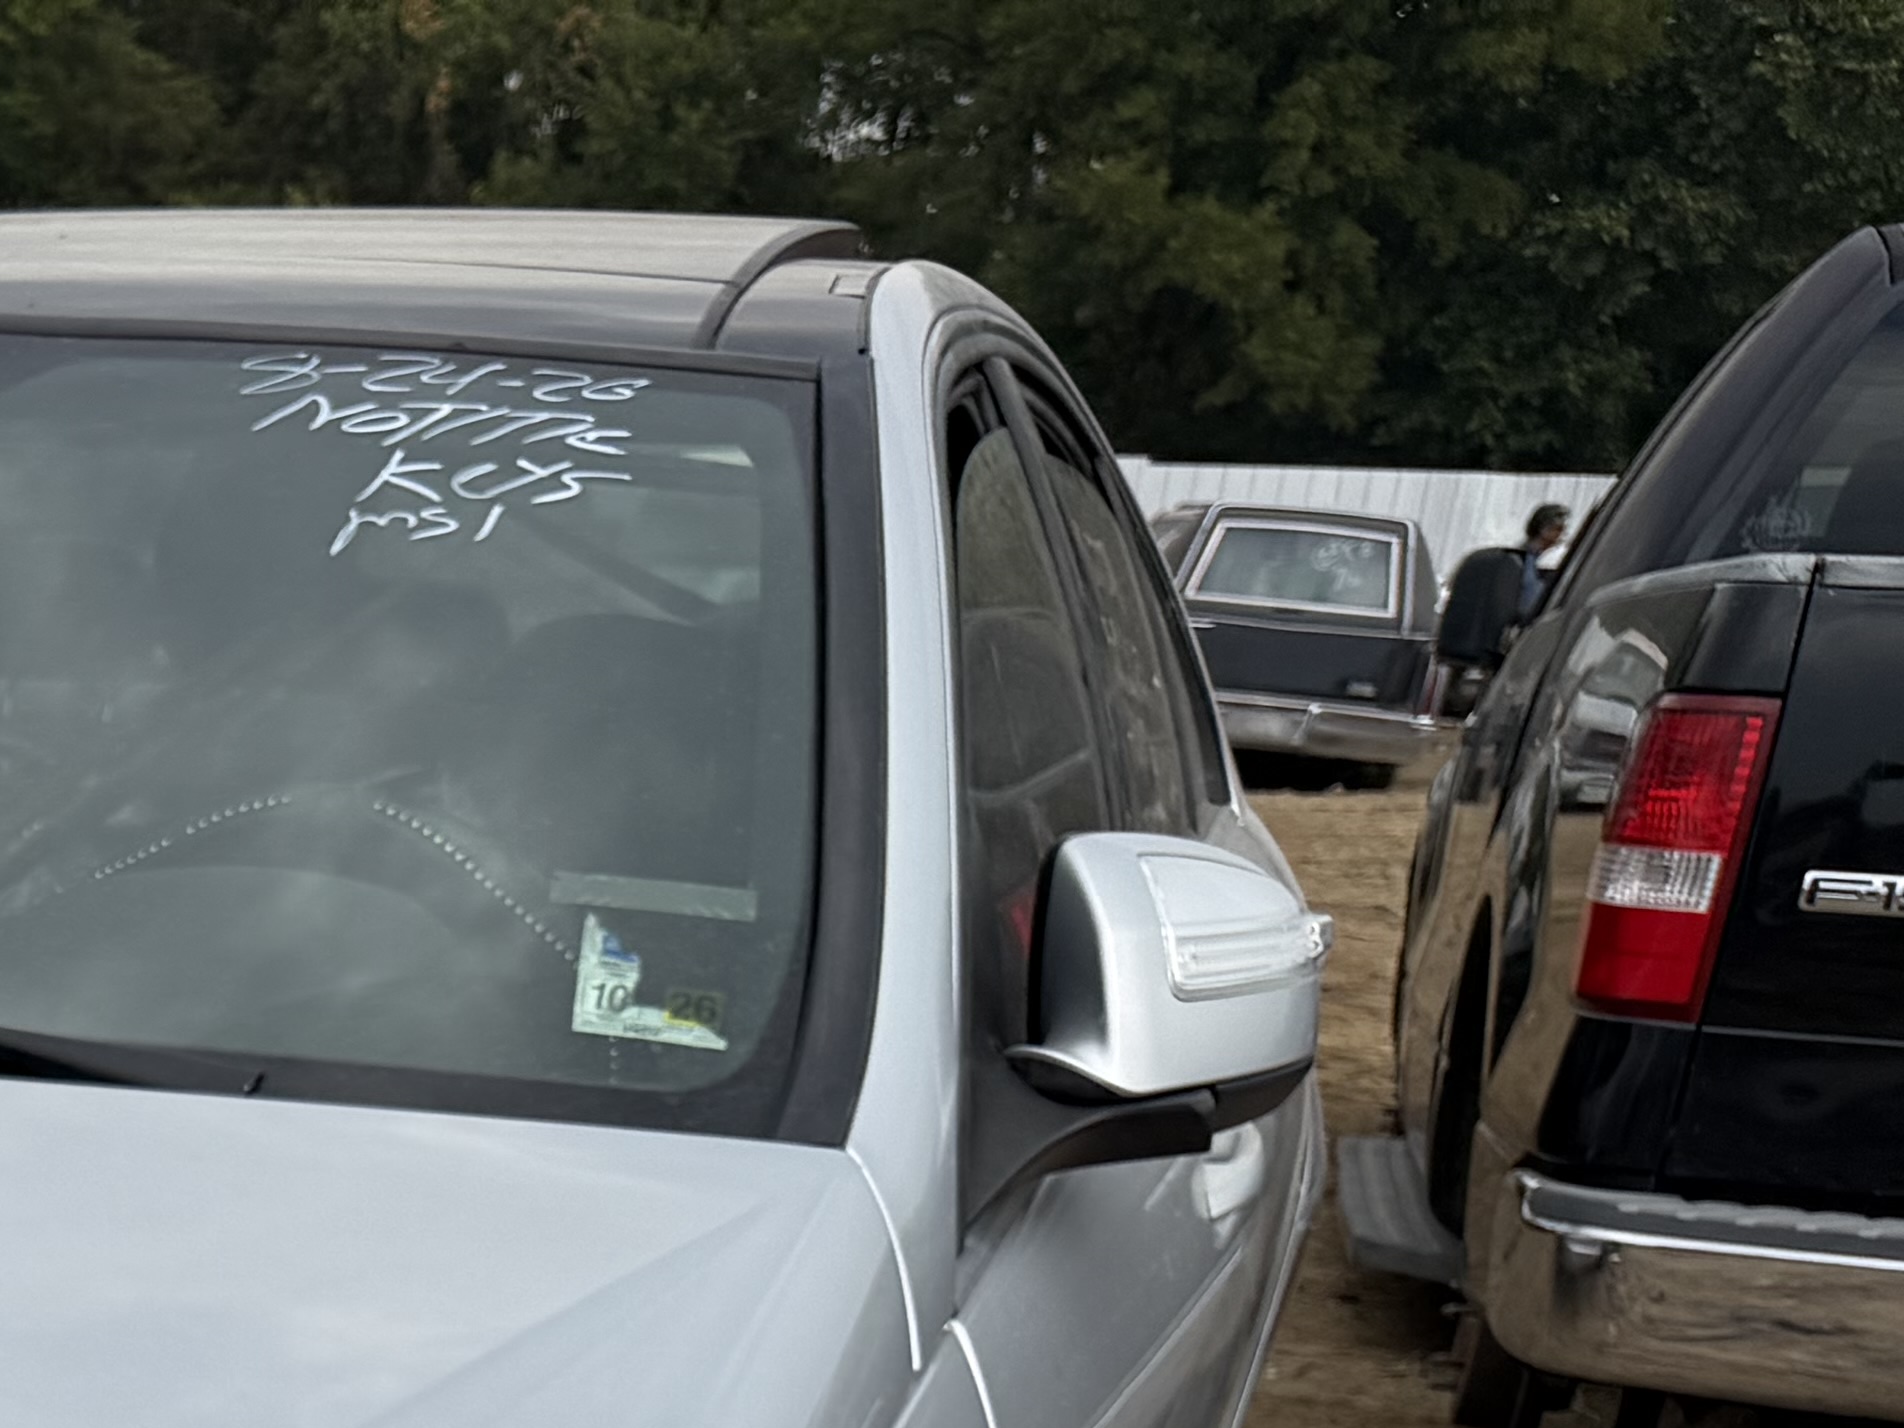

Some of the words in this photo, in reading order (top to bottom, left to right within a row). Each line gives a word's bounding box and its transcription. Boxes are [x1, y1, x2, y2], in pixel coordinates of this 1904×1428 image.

[1799, 870, 1904, 917] F-1
[592, 982, 629, 1013] 10
[670, 991, 717, 1025] 26
